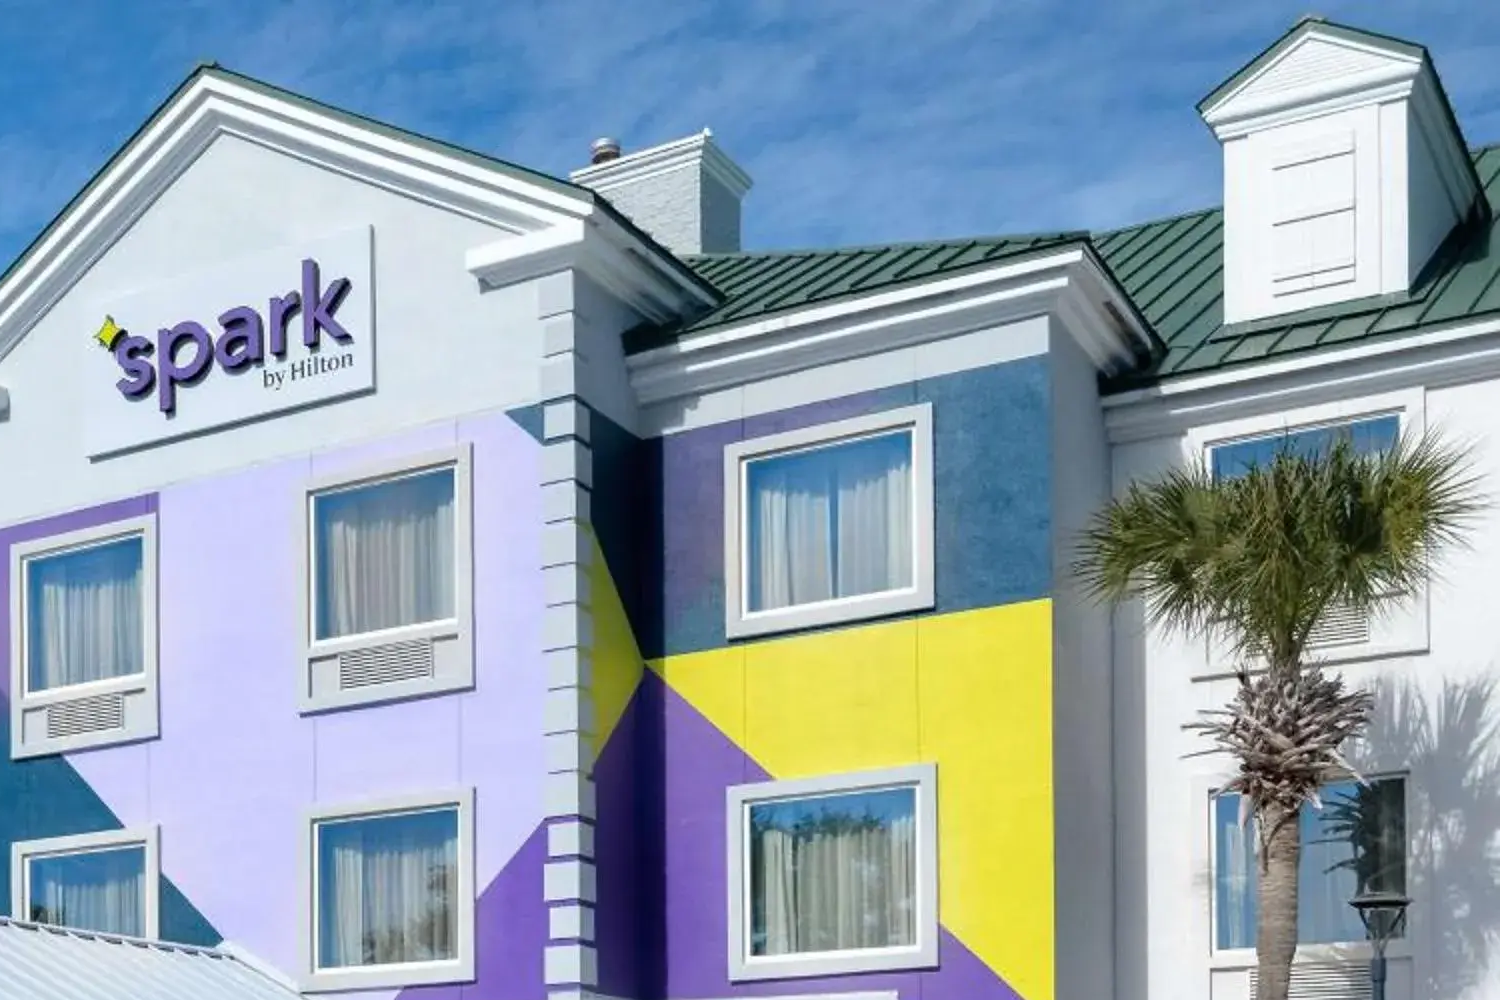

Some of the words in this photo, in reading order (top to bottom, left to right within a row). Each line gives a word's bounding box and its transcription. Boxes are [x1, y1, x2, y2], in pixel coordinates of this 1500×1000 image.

[115, 258, 352, 415] spark
[263, 369, 286, 390] by
[290, 353, 353, 381] Hilton
